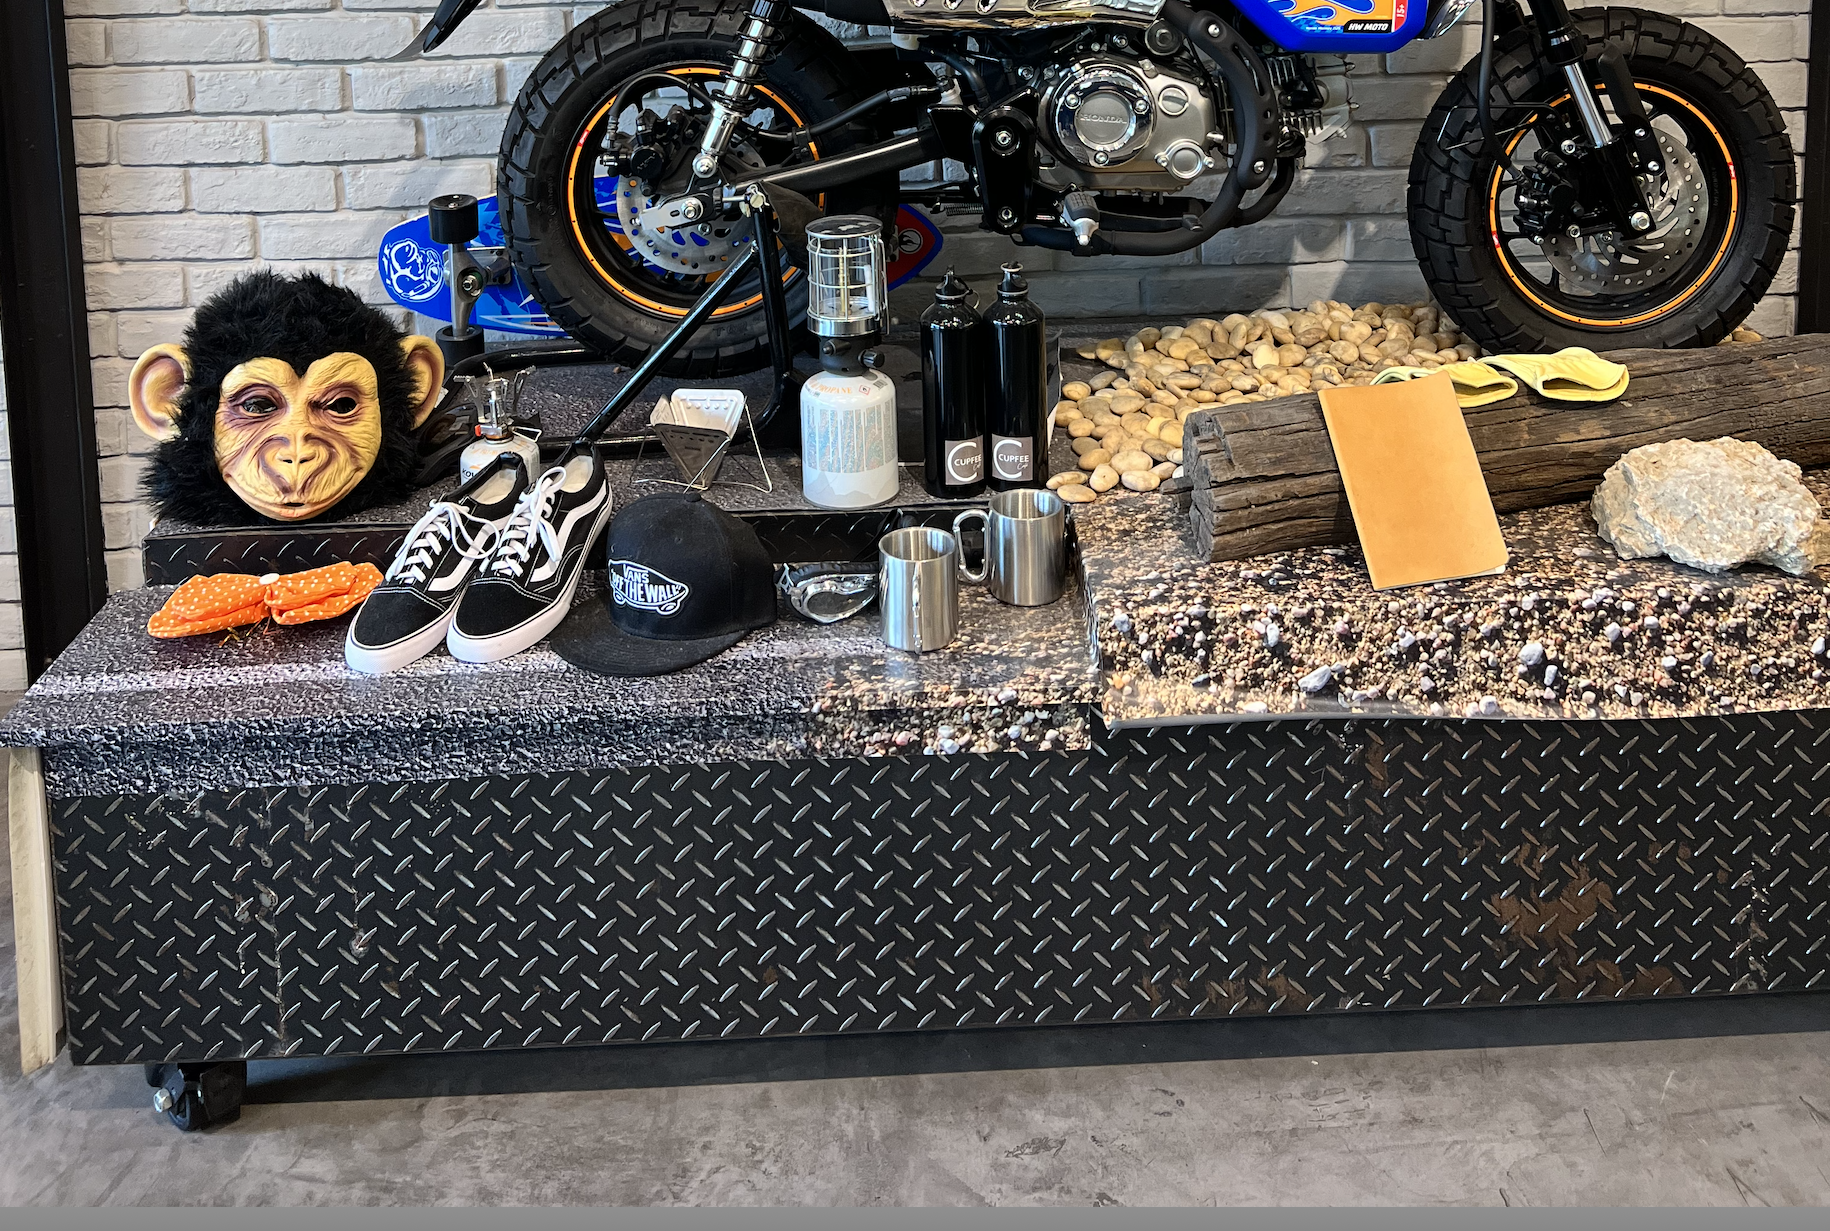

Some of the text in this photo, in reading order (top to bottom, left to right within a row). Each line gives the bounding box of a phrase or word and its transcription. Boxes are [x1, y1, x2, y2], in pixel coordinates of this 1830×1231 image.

[1348, 23, 1364, 31] HW
[1363, 23, 1389, 31] MOTO
[954, 454, 982, 466] CUPFEE
[998, 453, 1029, 463] CUPFEE
[623, 563, 650, 584] VANS
[623, 579, 646, 602] THE
